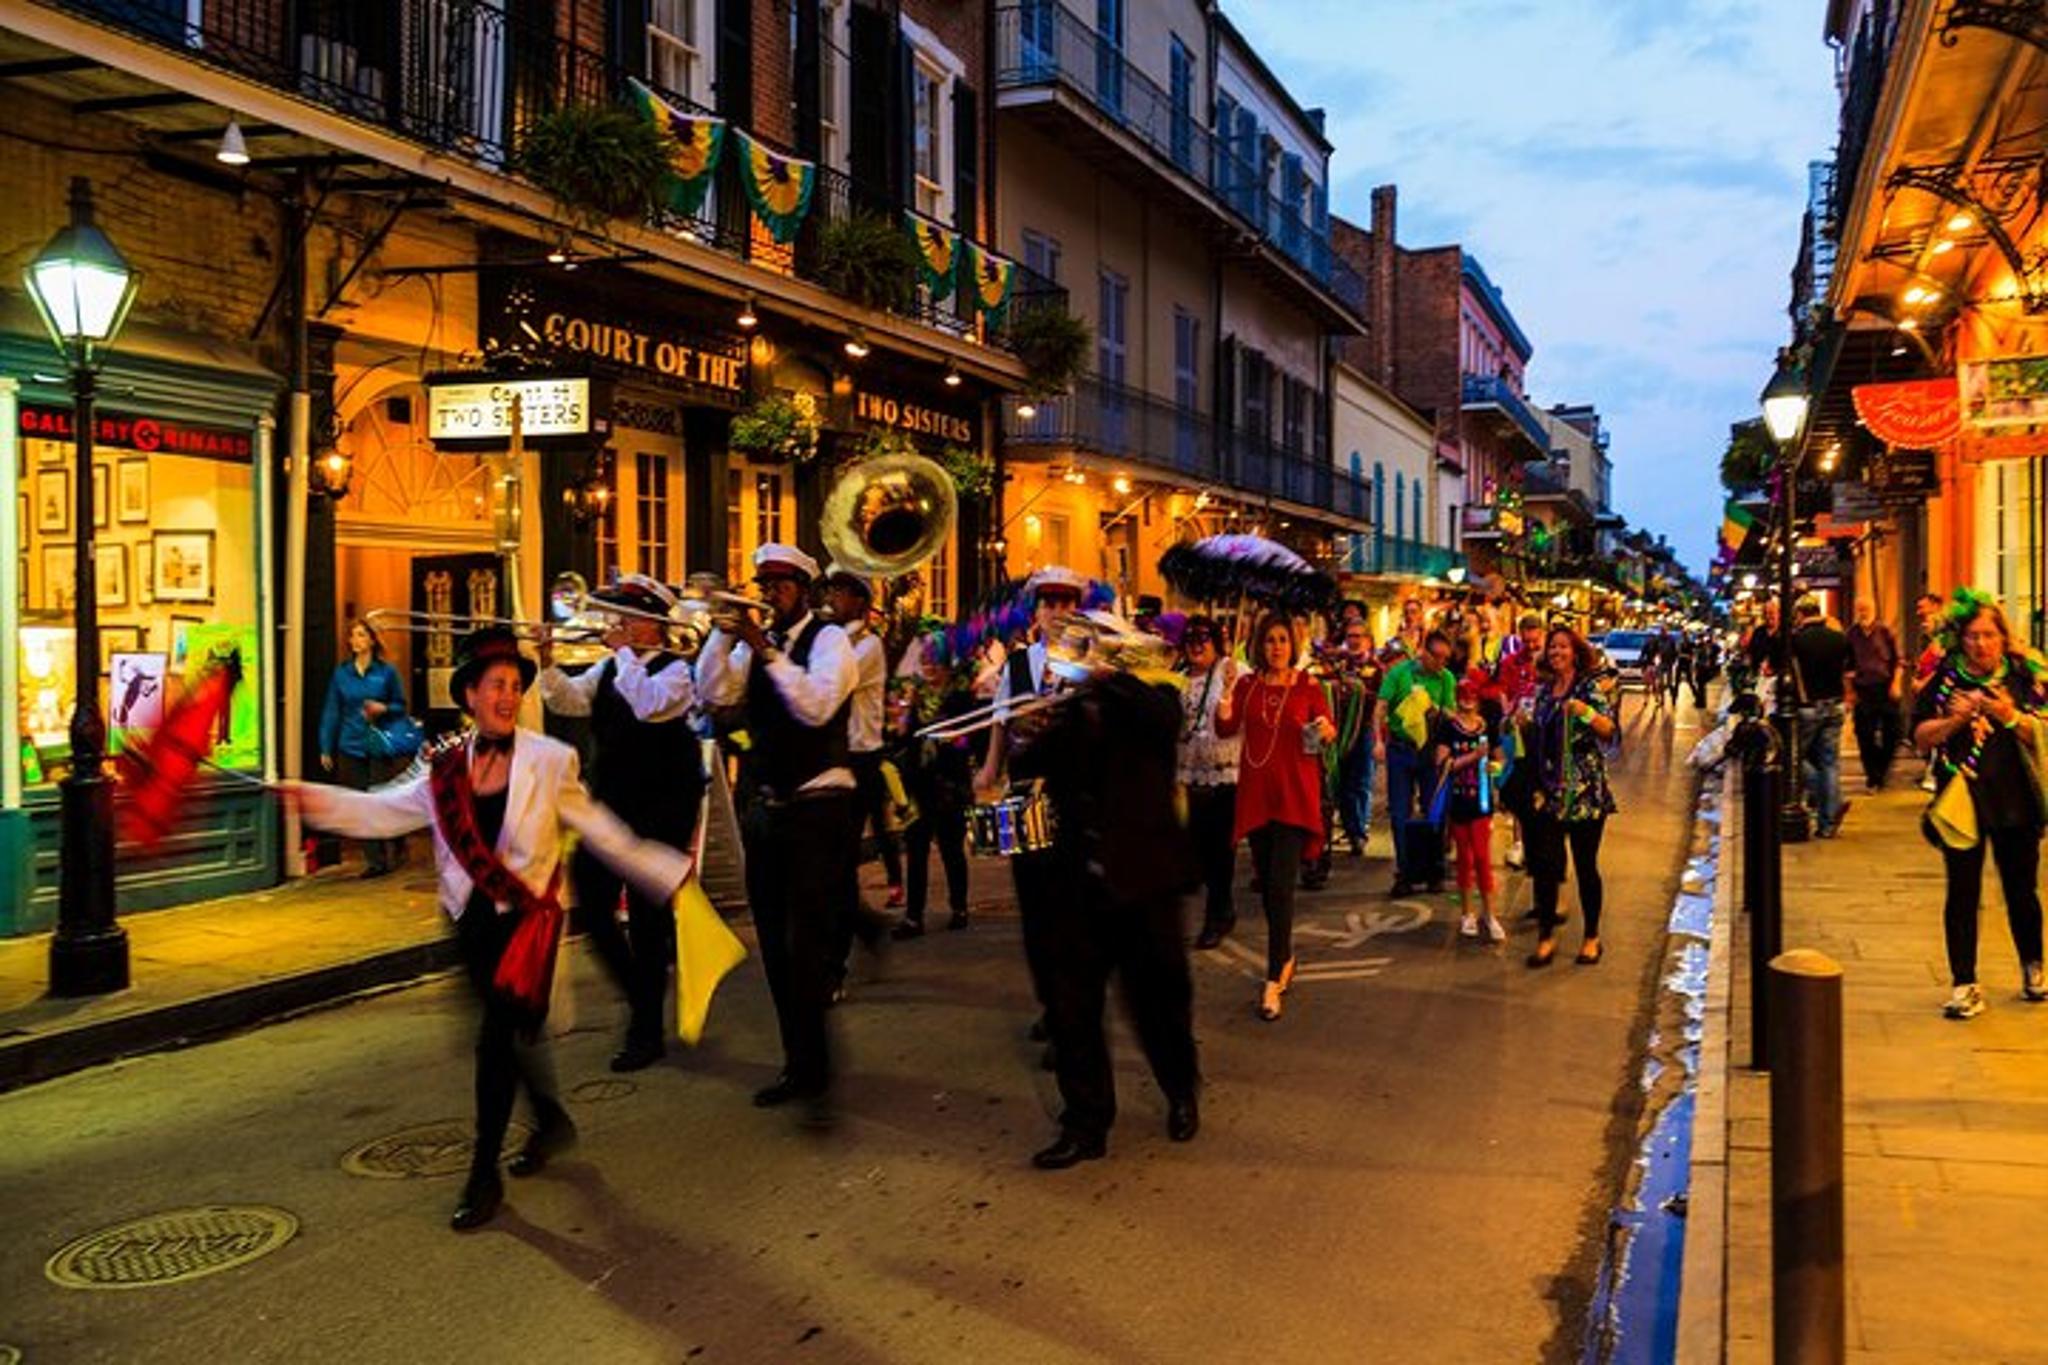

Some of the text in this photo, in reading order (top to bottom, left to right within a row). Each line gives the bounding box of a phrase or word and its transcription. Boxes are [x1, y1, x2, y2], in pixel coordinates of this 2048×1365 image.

[545, 313, 744, 390] COURT OF THE
[859, 391, 971, 442] TWO SISTERS
